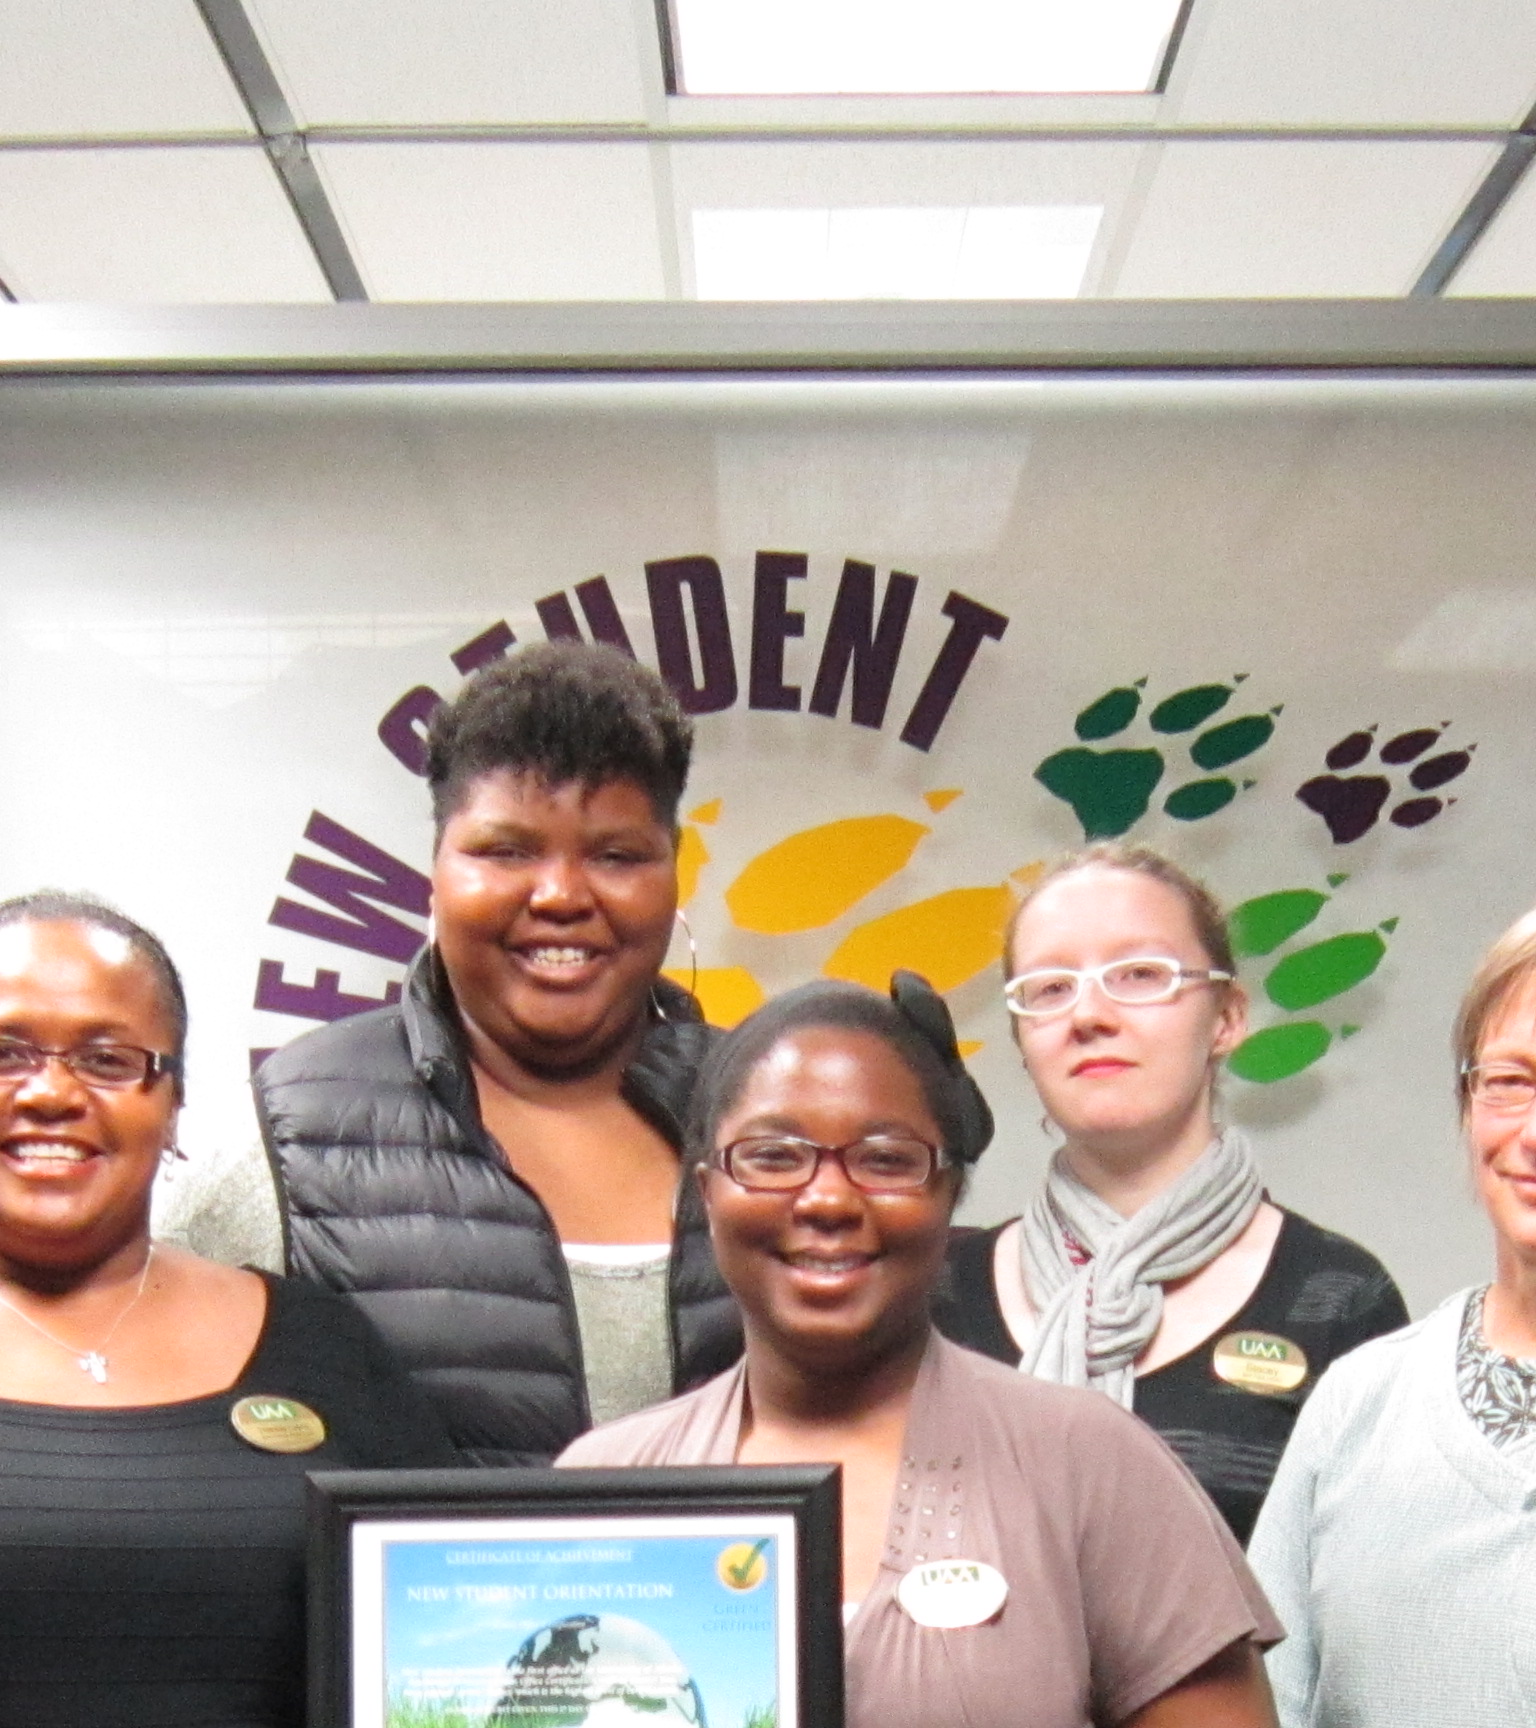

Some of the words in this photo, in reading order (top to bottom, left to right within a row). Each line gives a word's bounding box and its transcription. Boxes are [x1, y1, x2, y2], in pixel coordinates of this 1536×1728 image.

[249, 808, 434, 1083] EW
[446, 1550, 521, 1564] CERTIFICATE
[544, 1548, 632, 1562] ACHIEVEMENT
[407, 1586, 449, 1602] NEW
[454, 1585, 538, 1601] STUDENT
[543, 1582, 674, 1600] ORIENTATION
